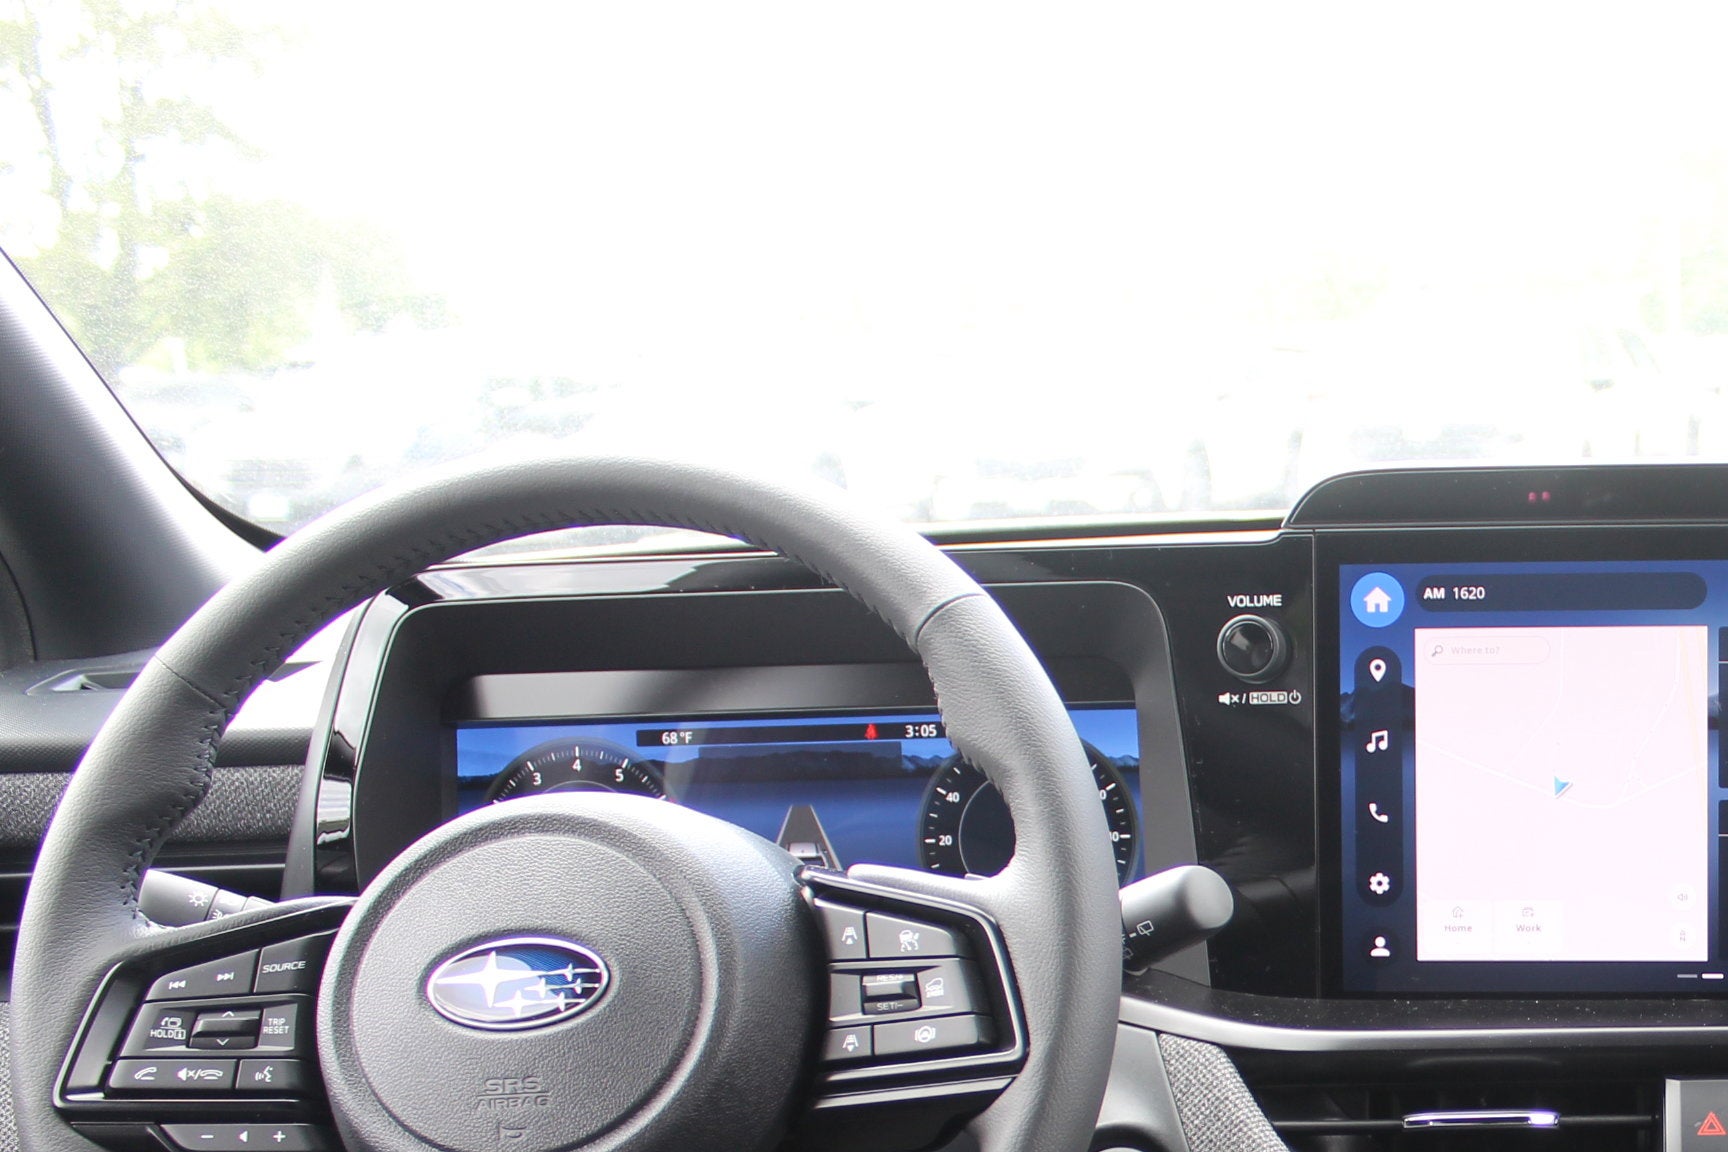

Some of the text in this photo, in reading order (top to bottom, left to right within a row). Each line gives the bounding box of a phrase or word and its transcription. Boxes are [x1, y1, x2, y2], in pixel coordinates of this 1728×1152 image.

[1423, 586, 1486, 600] AM 1620
[1227, 594, 1283, 608] VOLUME
[1450, 645, 1481, 656] Where
[1249, 691, 1287, 705] HOLD
[904, 723, 938, 738] 3:05
[572, 759, 583, 772] 4
[532, 773, 543, 786] 3
[614, 769, 625, 783] 5
[946, 791, 960, 804] 40
[938, 834, 953, 847] 20
[1444, 924, 1473, 933] Home
[1515, 923, 1542, 933] Work
[262, 960, 306, 974] SOURCE
[267, 1017, 286, 1026] TRIP
[150, 1029, 174, 1039] HOLD
[262, 1025, 290, 1035] RESET
[483, 1075, 542, 1094] SRS
[475, 1095, 550, 1111] AIRBAG
